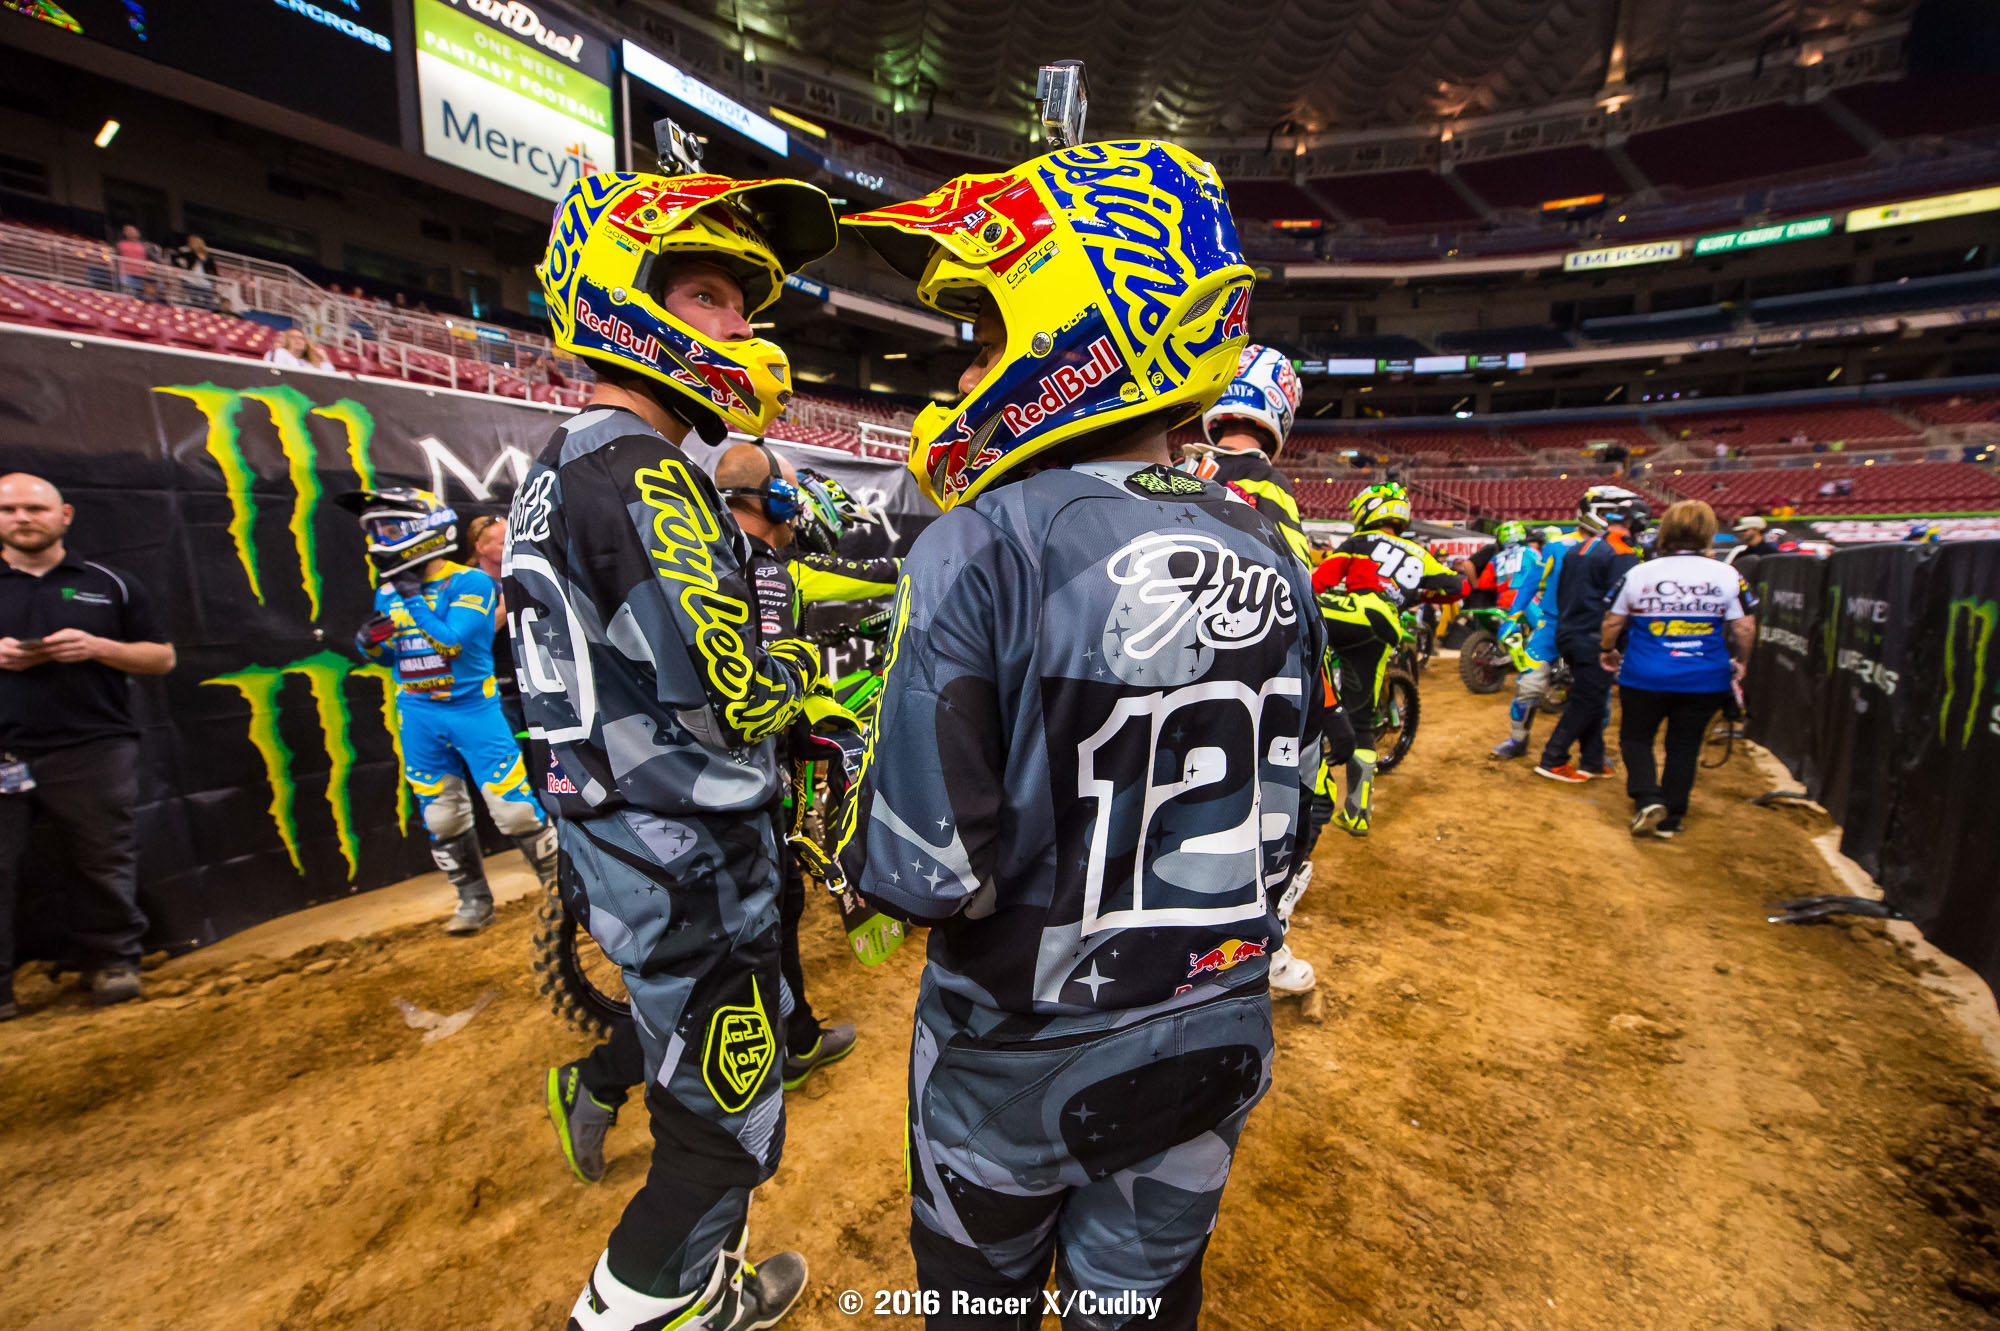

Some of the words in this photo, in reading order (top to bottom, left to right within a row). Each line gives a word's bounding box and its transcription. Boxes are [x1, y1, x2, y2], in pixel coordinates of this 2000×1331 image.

[450, 0, 584, 63] anDuel
[424, 30, 514, 84] FANTASY
[519, 67, 607, 128] FOOTBALL
[473, 31, 566, 87] ONE-WEEK
[699, 86, 750, 127] TOYOTA
[441, 99, 568, 188] Mercy
[604, 225, 641, 252] GoPro
[1006, 240, 1057, 285] GoPro
[1572, 243, 1677, 269] EMERSON
[577, 297, 617, 338] Red
[615, 318, 660, 364] Bull
[1002, 377, 1065, 438] Red
[1052, 334, 1124, 404] Bull
[634, 459, 720, 592] Troy
[680, 585, 754, 701] Lee
[1370, 541, 1425, 590] 48
[1655, 580, 1722, 600] Cycle
[1106, 534, 1298, 660] Frye
[1640, 597, 1725, 614] Trader
[547, 772, 570, 794] Red
